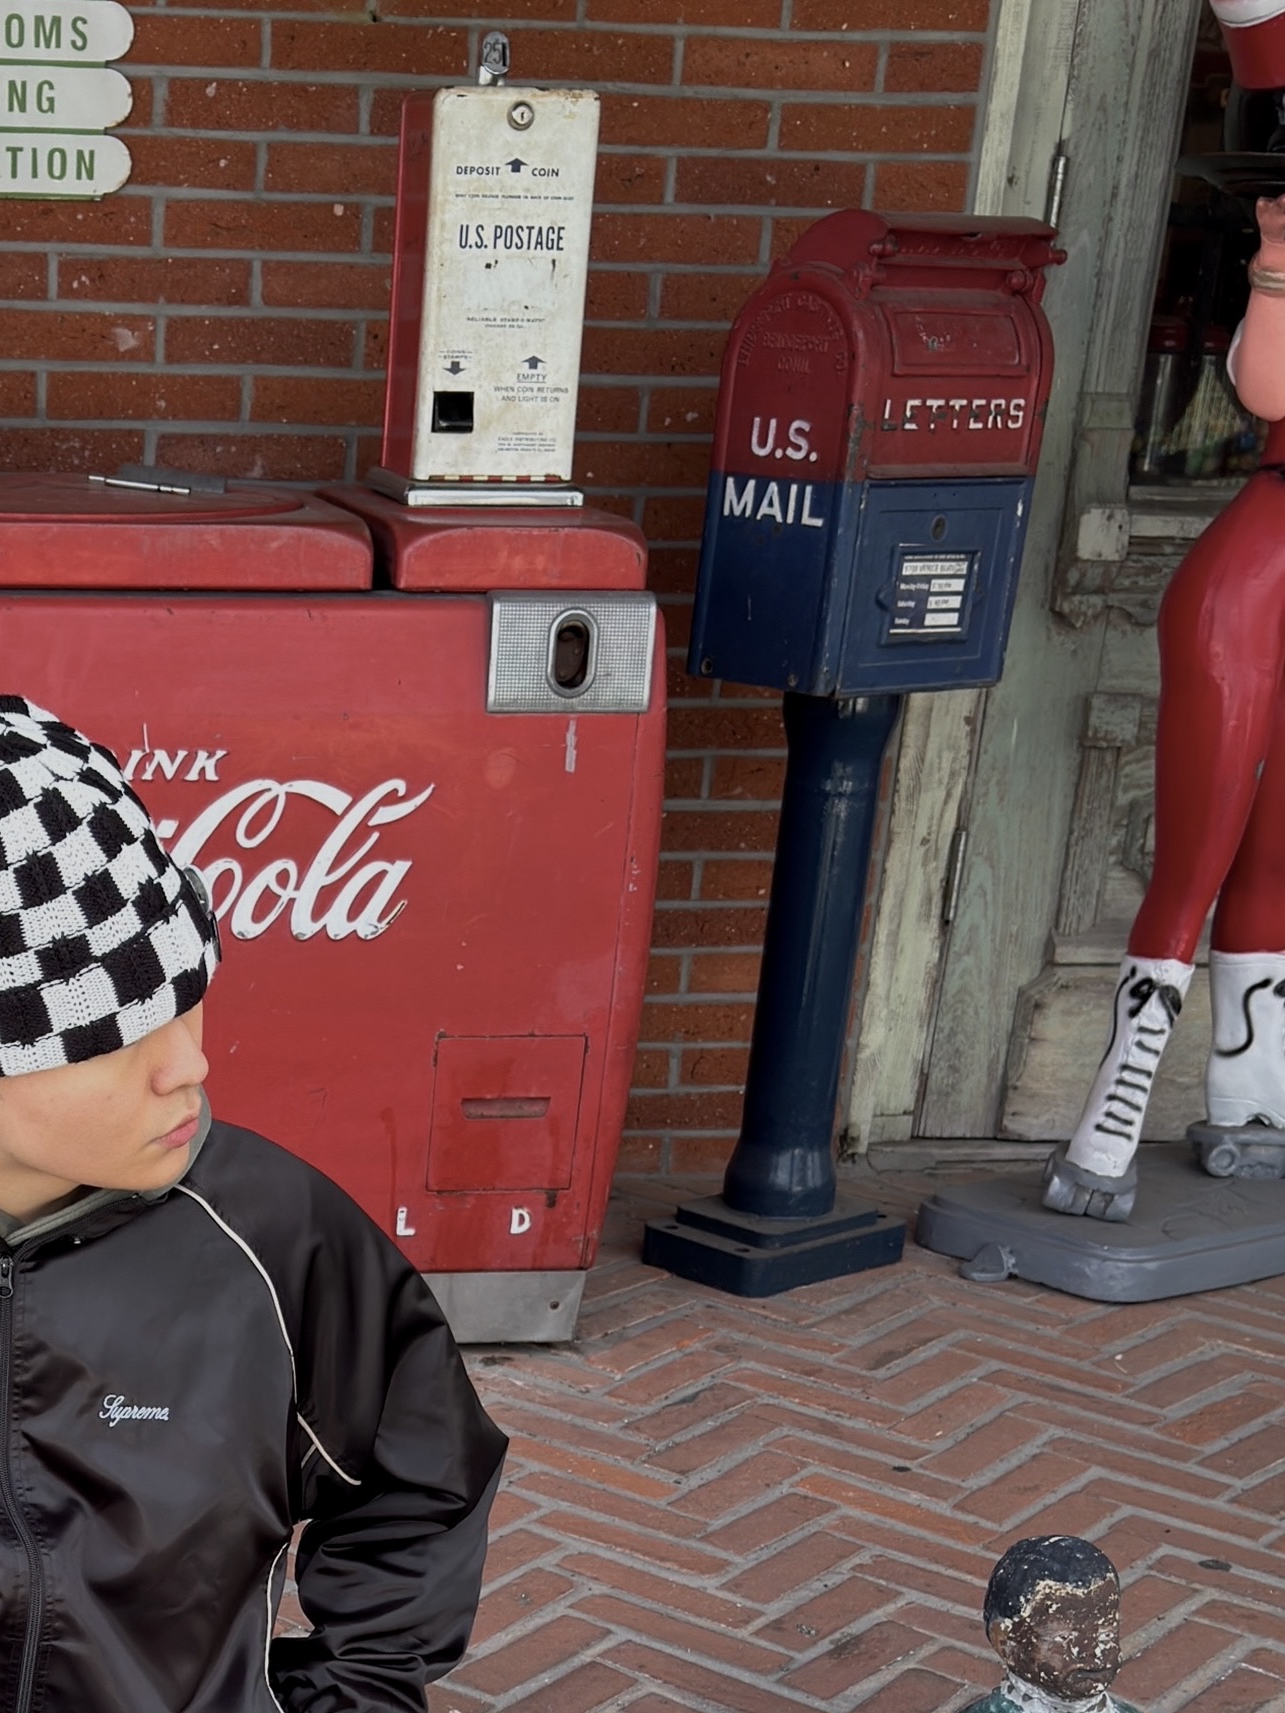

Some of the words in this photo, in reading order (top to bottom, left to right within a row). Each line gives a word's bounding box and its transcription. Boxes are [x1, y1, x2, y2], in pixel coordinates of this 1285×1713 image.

[456, 166, 501, 176] DEPOSIT
[531, 167, 560, 177] COIN
[459, 224, 488, 249] U.S.
[493, 225, 565, 251] POSTAGE
[517, 373, 547, 381] EMPTY
[517, 386, 534, 394] COIN
[881, 399, 1026, 431] LETTERS
[750, 417, 818, 462] U.S.
[723, 476, 824, 528] MAIL
[122, 749, 229, 781] INK
[156, 779, 436, 942] -Cola
[99, 1394, 170, 1428] Supreme
